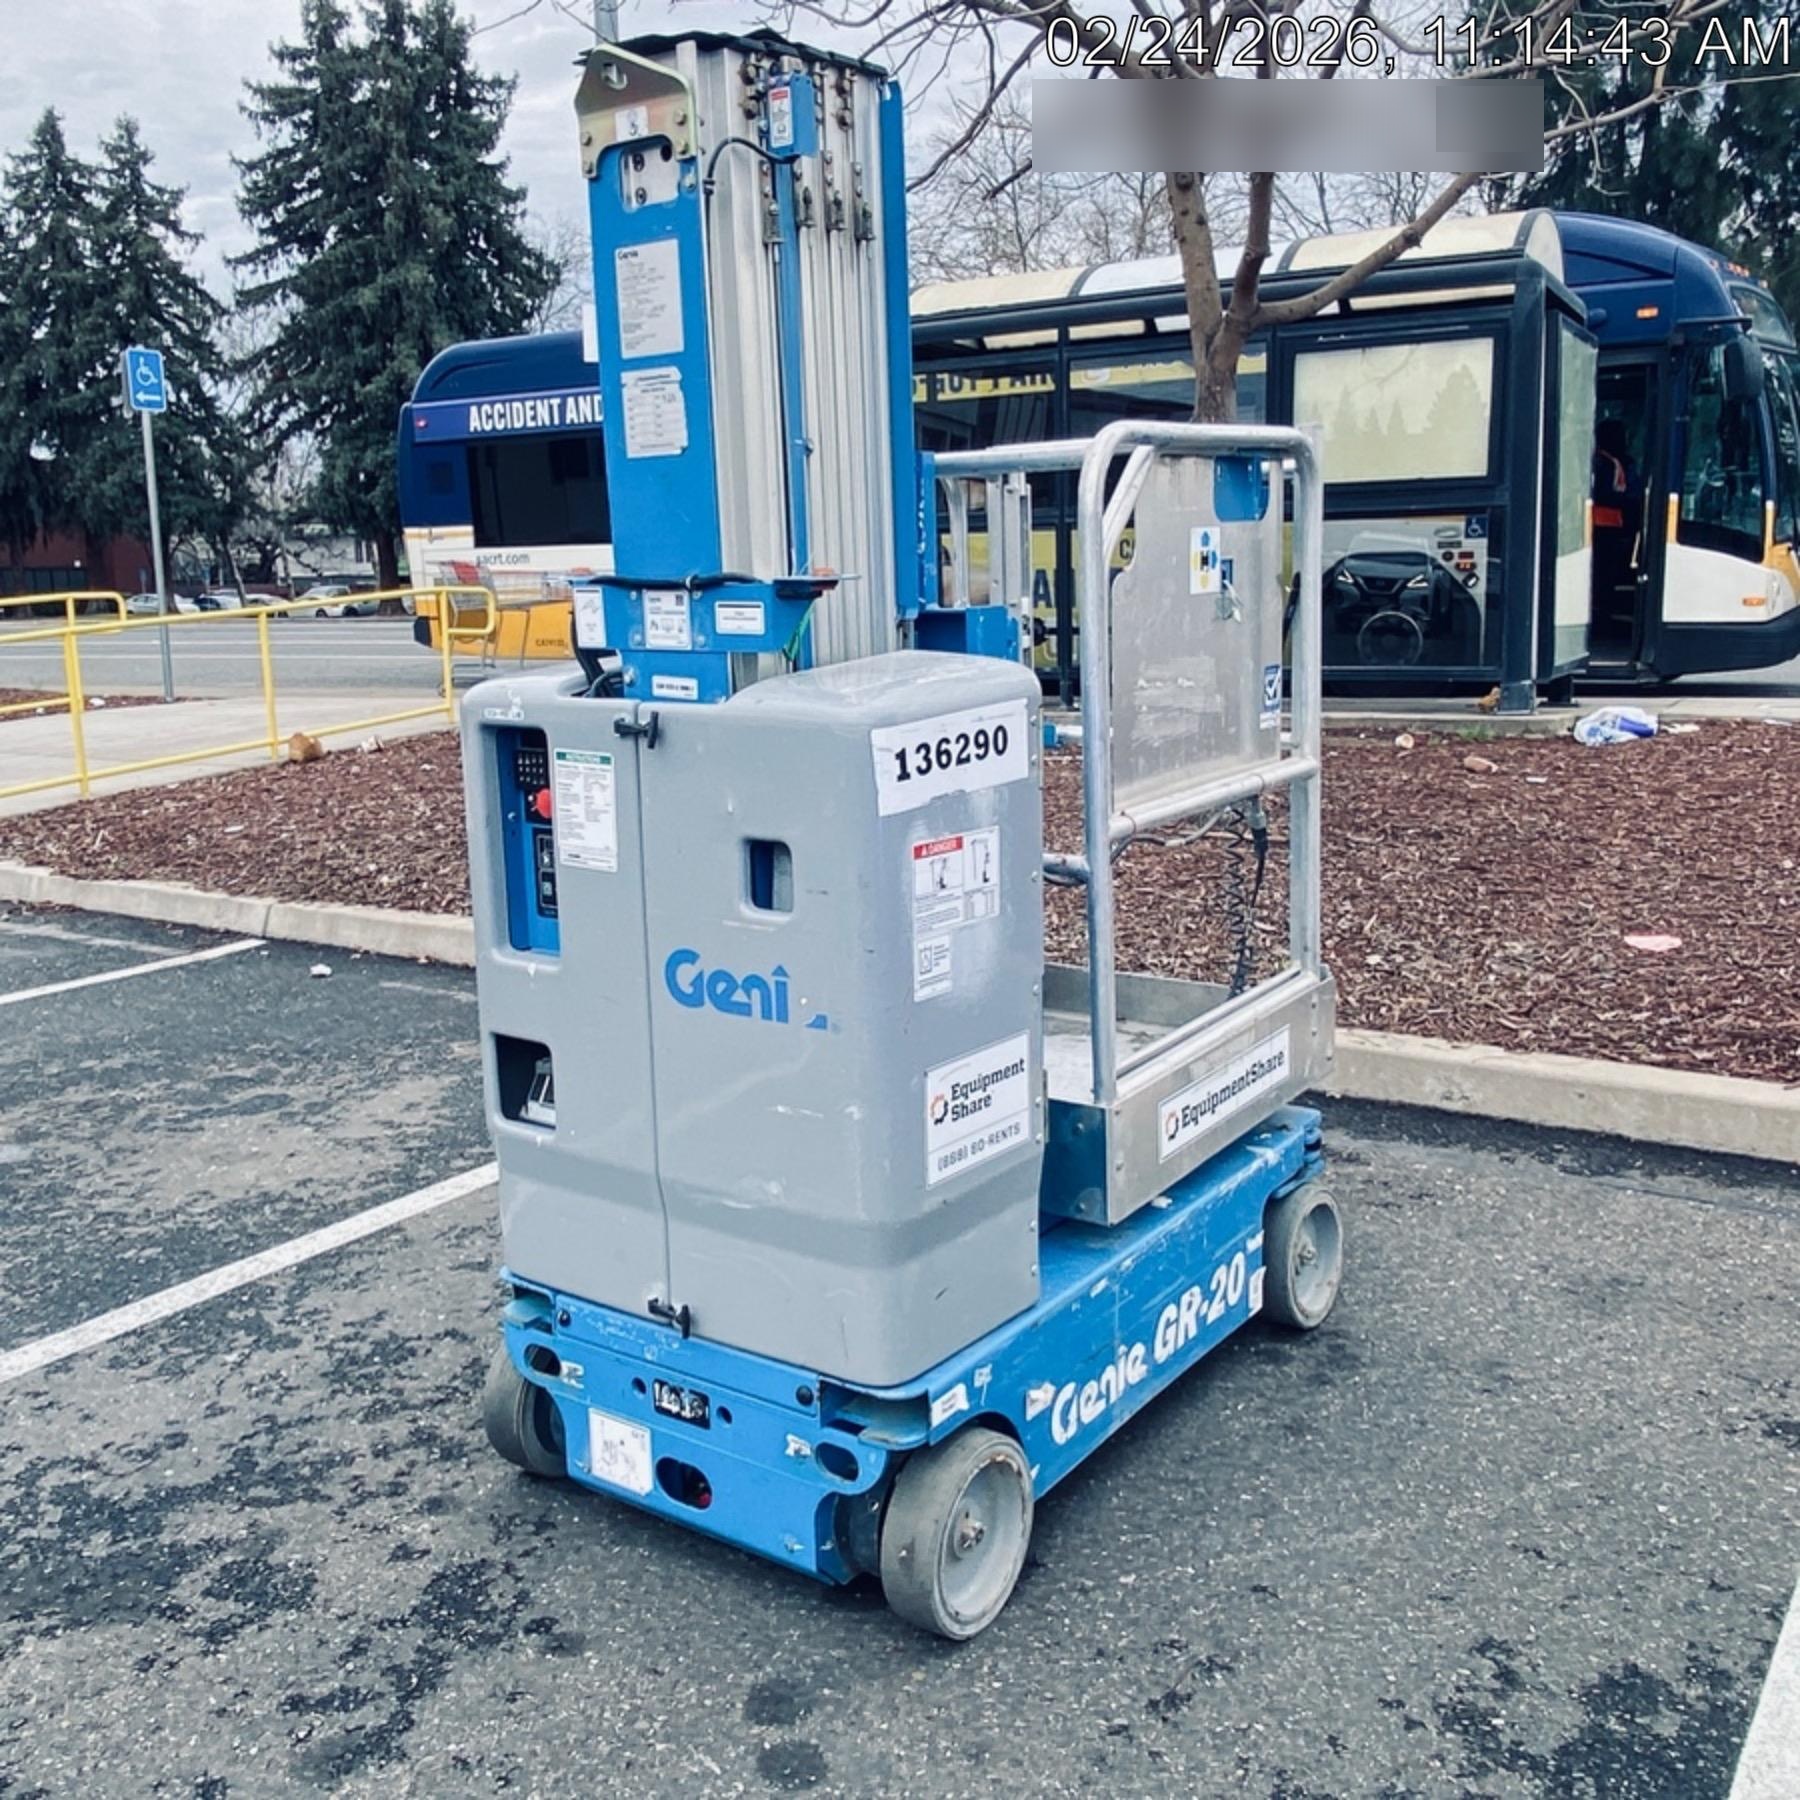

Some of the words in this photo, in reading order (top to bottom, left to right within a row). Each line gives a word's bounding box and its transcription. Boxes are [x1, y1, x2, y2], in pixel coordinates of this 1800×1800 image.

[469, 400, 561, 432] ACCIDENT
[895, 725, 1008, 783] 136290
[951, 1057, 1025, 1101] Equipment
[1181, 1051, 1285, 1129] EquipmentShare
[951, 1094, 992, 1122] Share
[1051, 1341, 1148, 1446] Genie
